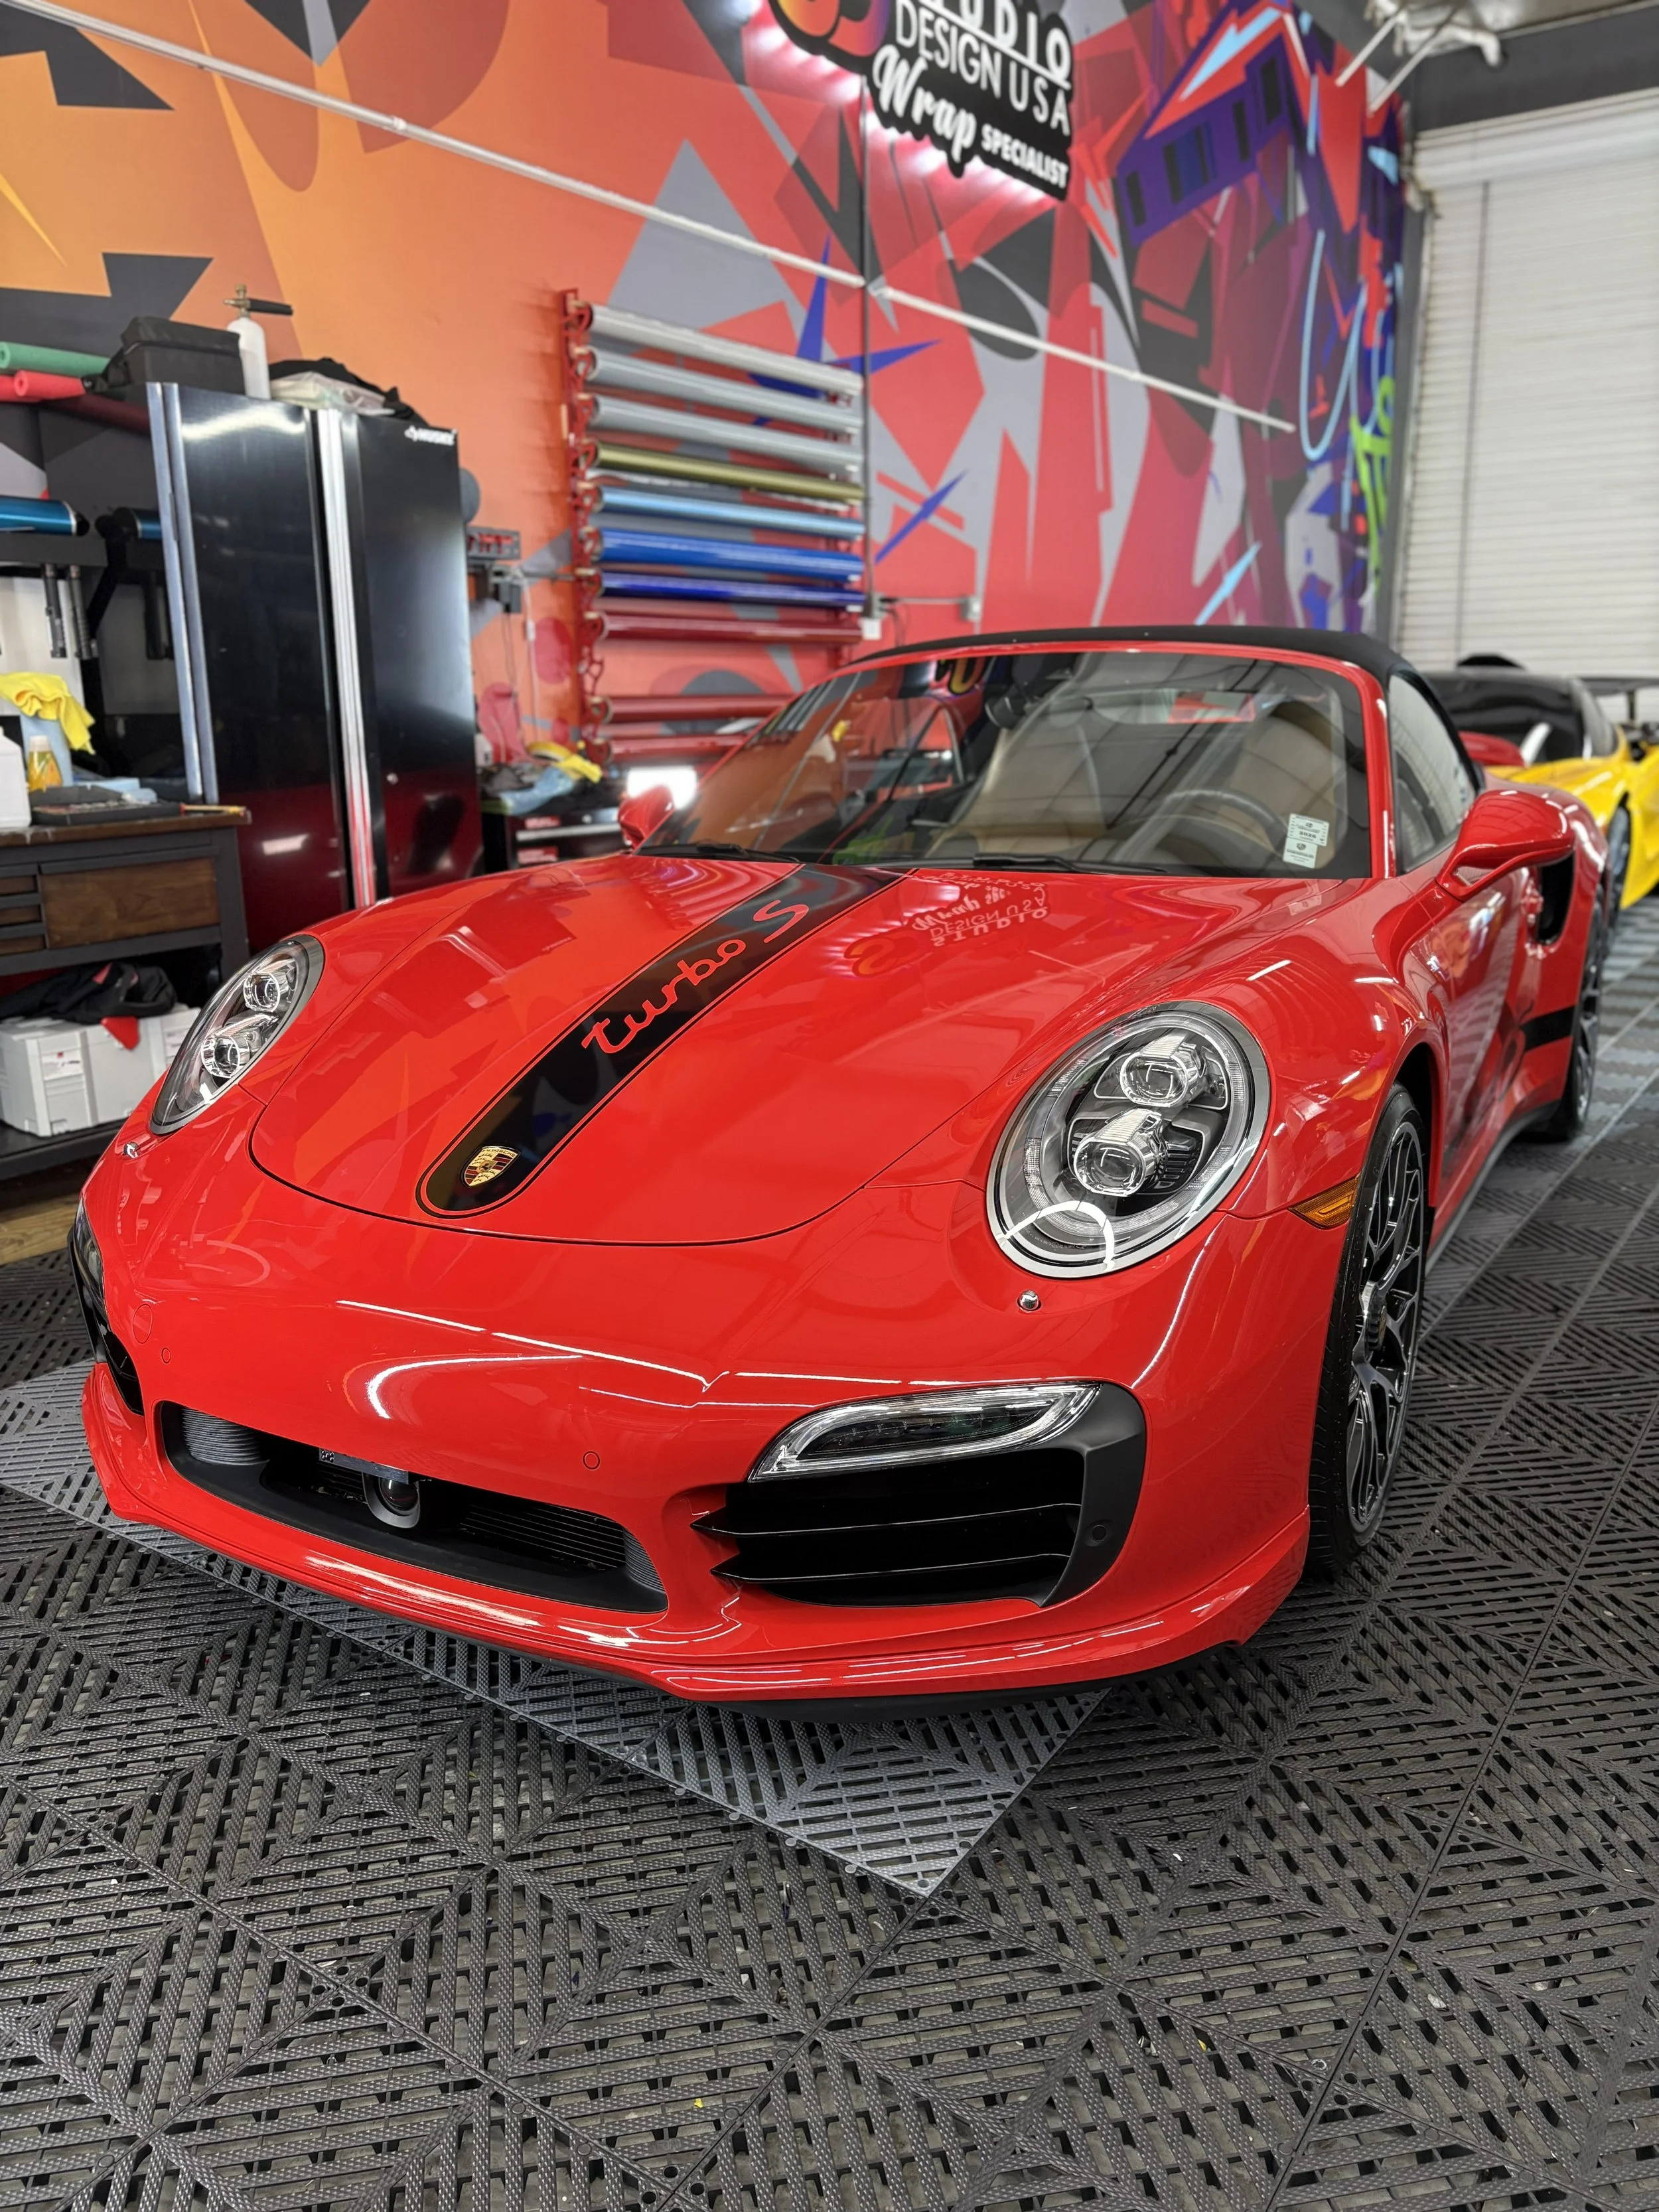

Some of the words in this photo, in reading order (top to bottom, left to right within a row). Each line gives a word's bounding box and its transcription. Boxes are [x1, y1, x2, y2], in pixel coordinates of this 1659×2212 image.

[896, 0, 1002, 100] DESIGN
[1009, 60, 1070, 137] USA
[934, 0, 1070, 81] UDIO
[872, 44, 977, 164] Wrap
[981, 123, 1068, 188] SPECIALIST
[581, 940, 746, 1053] turbo
[753, 900, 809, 943] S
